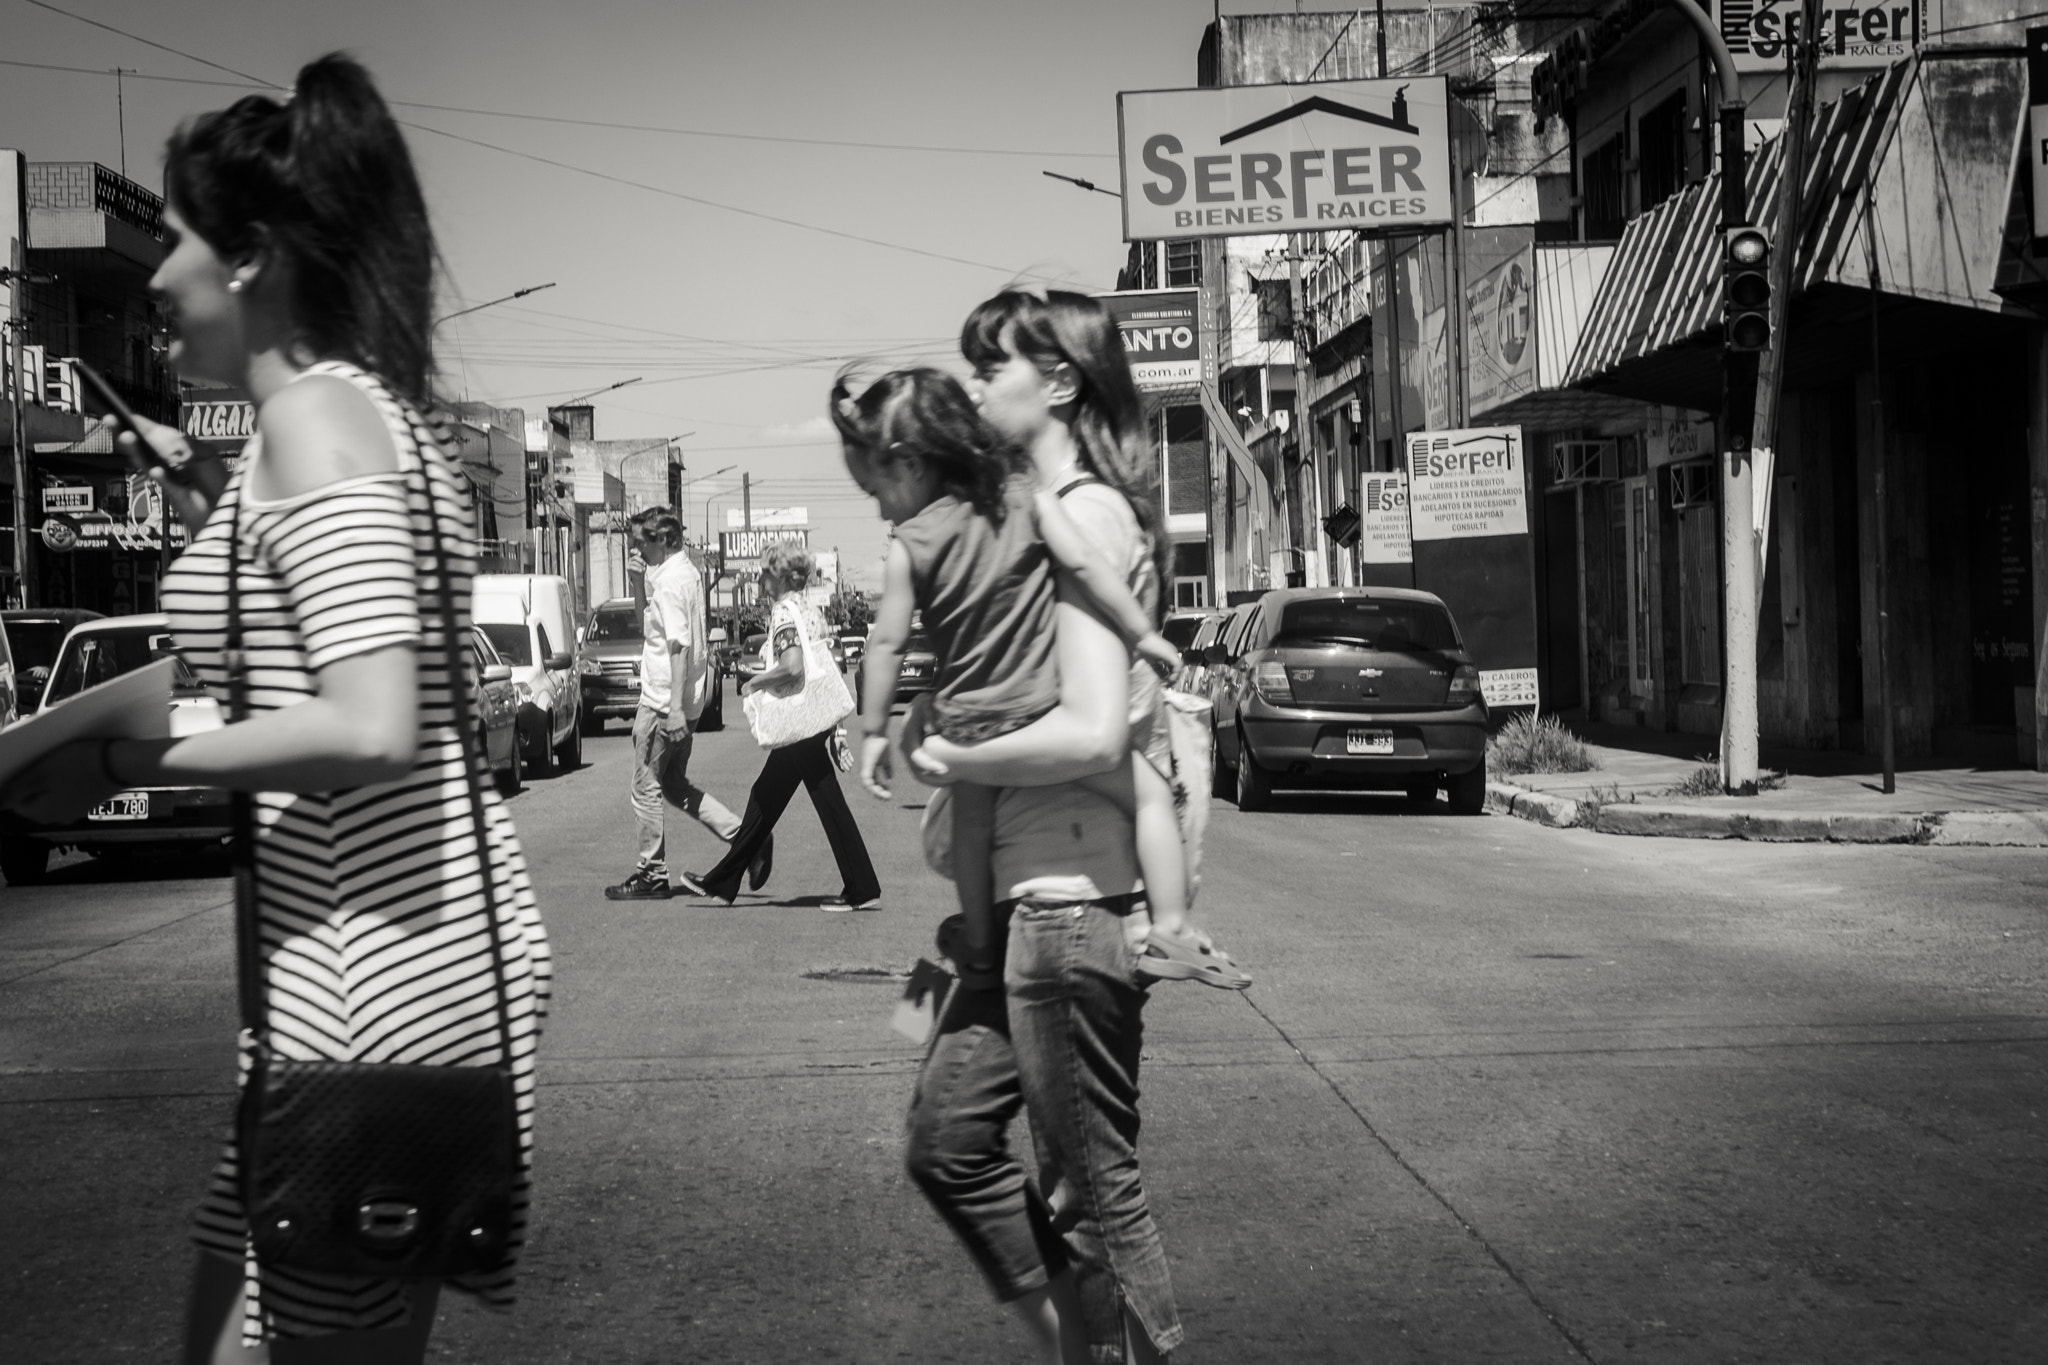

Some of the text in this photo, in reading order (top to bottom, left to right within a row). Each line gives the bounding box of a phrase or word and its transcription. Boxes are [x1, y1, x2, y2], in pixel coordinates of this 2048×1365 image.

[1142, 134, 1427, 219] SERFER
[1174, 198, 1427, 228] BIENES RAICES
[187, 404, 256, 437] ALGAR
[1429, 450, 1505, 477] SerFer
[1429, 478, 1505, 489] LIDERES EN CREDITOS
[1413, 487, 1523, 502] BANCARIOS Y EXTRABANCARIOS
[1420, 502, 1461, 512] ADELANTOS
[1473, 498, 1517, 508] SUCESIONES
[1434, 510, 1504, 522] HIPOTECAS RAPIDAS
[1452, 522, 1488, 532] CONSULTE
[1492, 672, 1535, 681] CASEROS
[122, 800, 146, 815] 780
